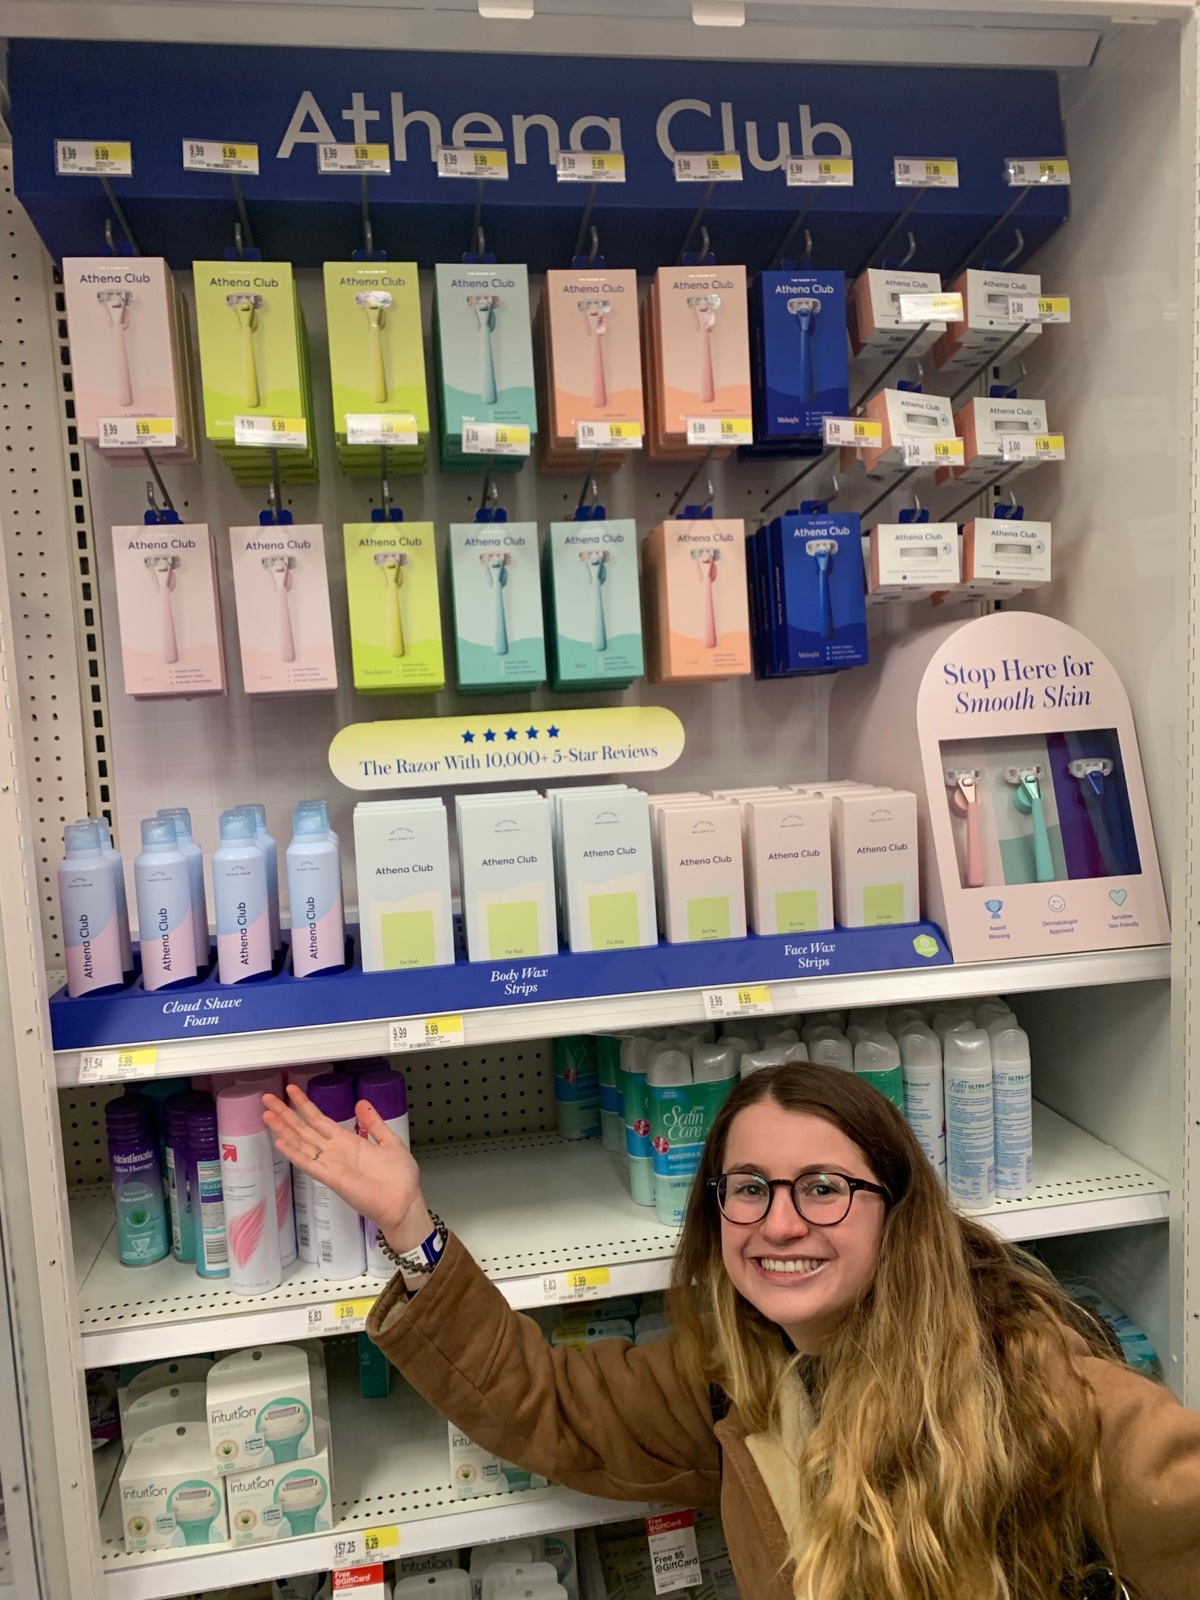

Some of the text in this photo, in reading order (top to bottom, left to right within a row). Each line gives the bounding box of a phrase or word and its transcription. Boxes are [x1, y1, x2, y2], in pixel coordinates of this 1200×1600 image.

[277, 90, 852, 172] Athena Club
[62, 147, 76, 159] 9.99
[95, 149, 109, 161] 9.99
[190, 144, 204, 156] 9.99
[223, 147, 236, 159] 9.99
[323, 148, 337, 159] 9.99
[355, 148, 368, 159] 9.99
[819, 163, 831, 173] 9.99
[925, 165, 939, 175] 11.99
[80, 273, 151, 284] Athena Club
[210, 277, 279, 288] Athena Club
[339, 277, 406, 287] Athena Club
[451, 279, 515, 289] Athena Club
[885, 279, 928, 289] Athena Club
[562, 284, 625, 294] Athena Club
[672, 280, 734, 291] Athena Club
[775, 284, 834, 294] Athena Club
[983, 279, 1028, 291] Athena Club
[1012, 302, 1023, 313] 3.00
[1038, 303, 1053, 313] 11.99
[900, 399, 940, 412] Athena Club
[989, 406, 1033, 416] Athena Club
[104, 423, 117, 435] 9.99
[136, 424, 149, 435] 9.99
[241, 419, 254, 430] 9.99
[272, 421, 285, 432] 9.99
[908, 445, 920, 456] 3.00
[935, 445, 949, 456] 11.99
[1009, 440, 1020, 451] 3.00
[1035, 440, 1050, 450] 11.99
[677, 533, 734, 543] Athena Club
[793, 526, 850, 538] Athena Club
[895, 532, 943, 541] Athena Club
[991, 529, 1037, 539] Athena Club
[128, 539, 196, 550] Athena Club
[246, 540, 312, 551] Athena Club
[359, 537, 422, 547] Athena Club
[464, 537, 526, 547] Athena Club
[565, 534, 625, 545] Athena Club
[943, 654, 1094, 689] Stop Here for
[955, 684, 1093, 714] Smooth Skin
[360, 745, 659, 776] The Razor With 10,000+ 5-Star Reviews
[582, 846, 637, 858] Athena Club
[856, 842, 908, 855] Athena Club
[481, 854, 538, 867] Athena Club
[679, 854, 732, 867] Athena Club
[768, 849, 821, 861] Athena Club
[375, 863, 434, 876] Athena Club
[1042, 918, 1079, 928] Dermatologist
[1111, 913, 1133, 921] Sensitive
[305, 896, 319, 960] Athena Club
[989, 924, 1007, 932] Award
[1049, 926, 1075, 936] Approved
[1107, 920, 1140, 930] Skin Friendly
[158, 907, 172, 972] Athena Club
[236, 901, 250, 966] Athena Club
[988, 932, 1011, 941] Winning
[79, 914, 94, 979] Athena Club
[784, 942, 836, 956] Face Wax
[798, 957, 830, 970] Strips
[490, 967, 549, 983] Body Wax
[504, 983, 538, 996] Strips
[709, 995, 723, 1007] 9.99
[738, 993, 752, 1004] 9.99
[162, 997, 243, 1014] Cloud Shave
[182, 1014, 220, 1028] Foam
[393, 1027, 407, 1039] 9.99
[425, 1024, 439, 1036] 9.99
[118, 1056, 133, 1067] 5.99
[662, 1105, 704, 1127] Satin
[668, 1125, 703, 1141] Care
[113, 1150, 154, 1165] Skintimate
[115, 1163, 154, 1173] Skin Therapy
[543, 1279, 557, 1291] 6.83
[574, 1276, 587, 1288] 2.99
[308, 1310, 322, 1322] 6.83
[340, 1307, 354, 1318] 2.99
[211, 1406, 257, 1424] Intuition
[230, 1477, 275, 1493] Intuition
[123, 1485, 168, 1500] Intuition
[648, 1518, 663, 1526] Free
[334, 1541, 356, 1556] 157.25
[365, 1537, 379, 1550] 6.29
[654, 1551, 685, 1565] Free $5
[401, 1557, 453, 1573] Intuition
[662, 1557, 698, 1572] GiftCard
[334, 1571, 351, 1579] Free
